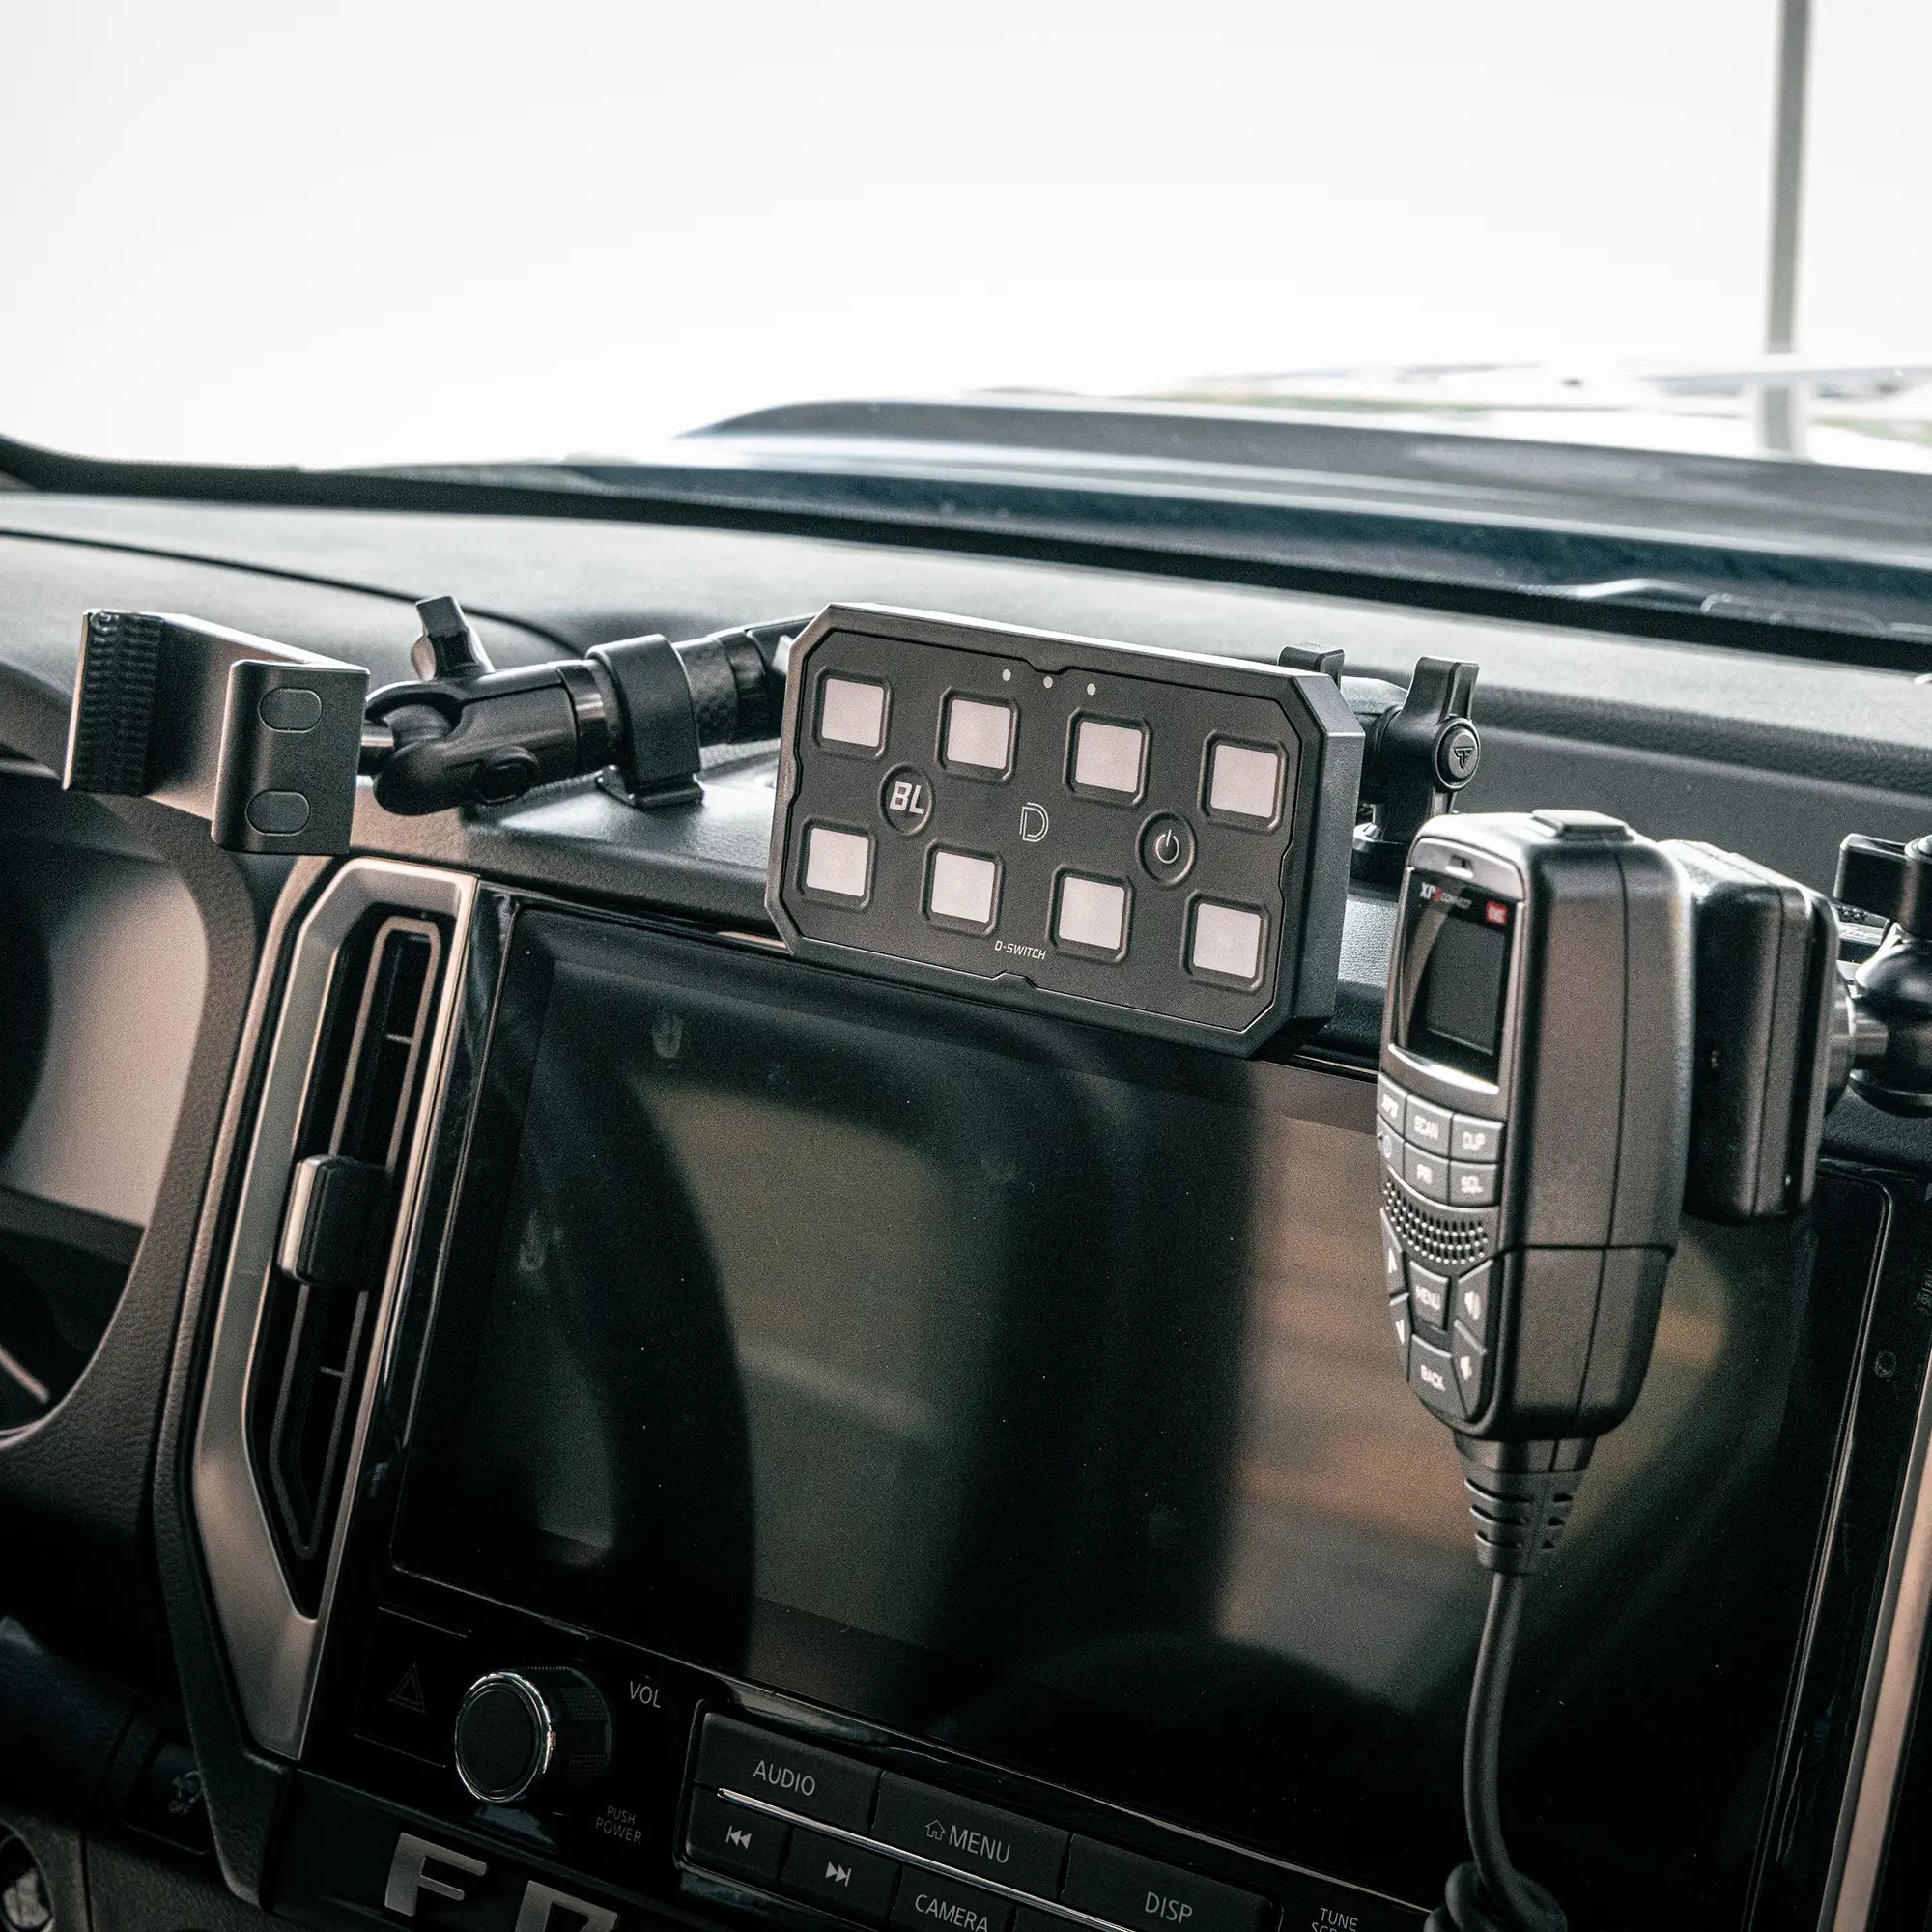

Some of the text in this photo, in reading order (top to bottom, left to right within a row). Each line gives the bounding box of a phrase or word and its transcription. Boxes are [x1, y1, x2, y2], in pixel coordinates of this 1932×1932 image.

[889, 781, 924, 815] BL
[994, 939, 1047, 961] D-SWITCH
[629, 1680, 662, 1709] VOL
[753, 1759, 816, 1797] AUDIO
[607, 1805, 637, 1825] PUSH
[595, 1817, 642, 1845] POWER
[949, 1824, 1011, 1864] MENU
[915, 1893, 988, 1932] CAMERA
[1144, 1890, 1193, 1924] DISP
[1320, 1907, 1359, 1932] TUNE
